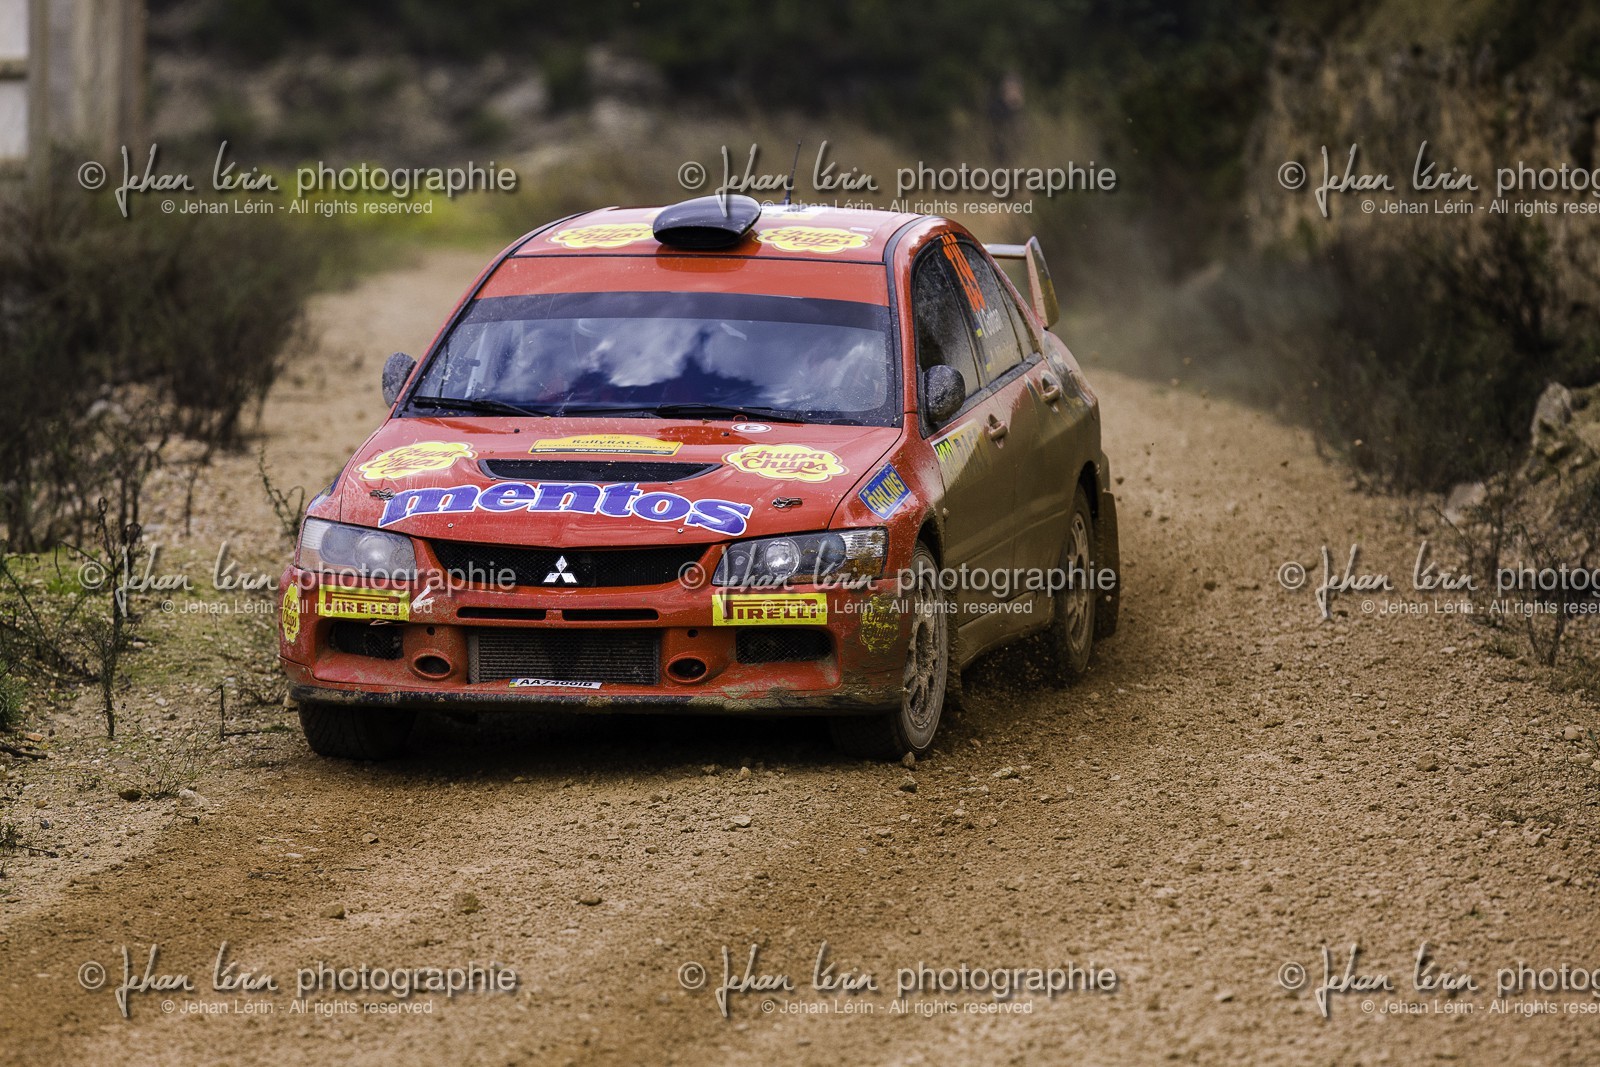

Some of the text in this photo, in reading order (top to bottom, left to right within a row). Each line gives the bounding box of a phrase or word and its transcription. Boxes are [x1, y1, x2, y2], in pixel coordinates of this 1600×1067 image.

[741, 457, 829, 475] Chups
[377, 481, 752, 537] mentos
[863, 471, 906, 515] ÖHLINS
[722, 597, 818, 620] PIRELLI
